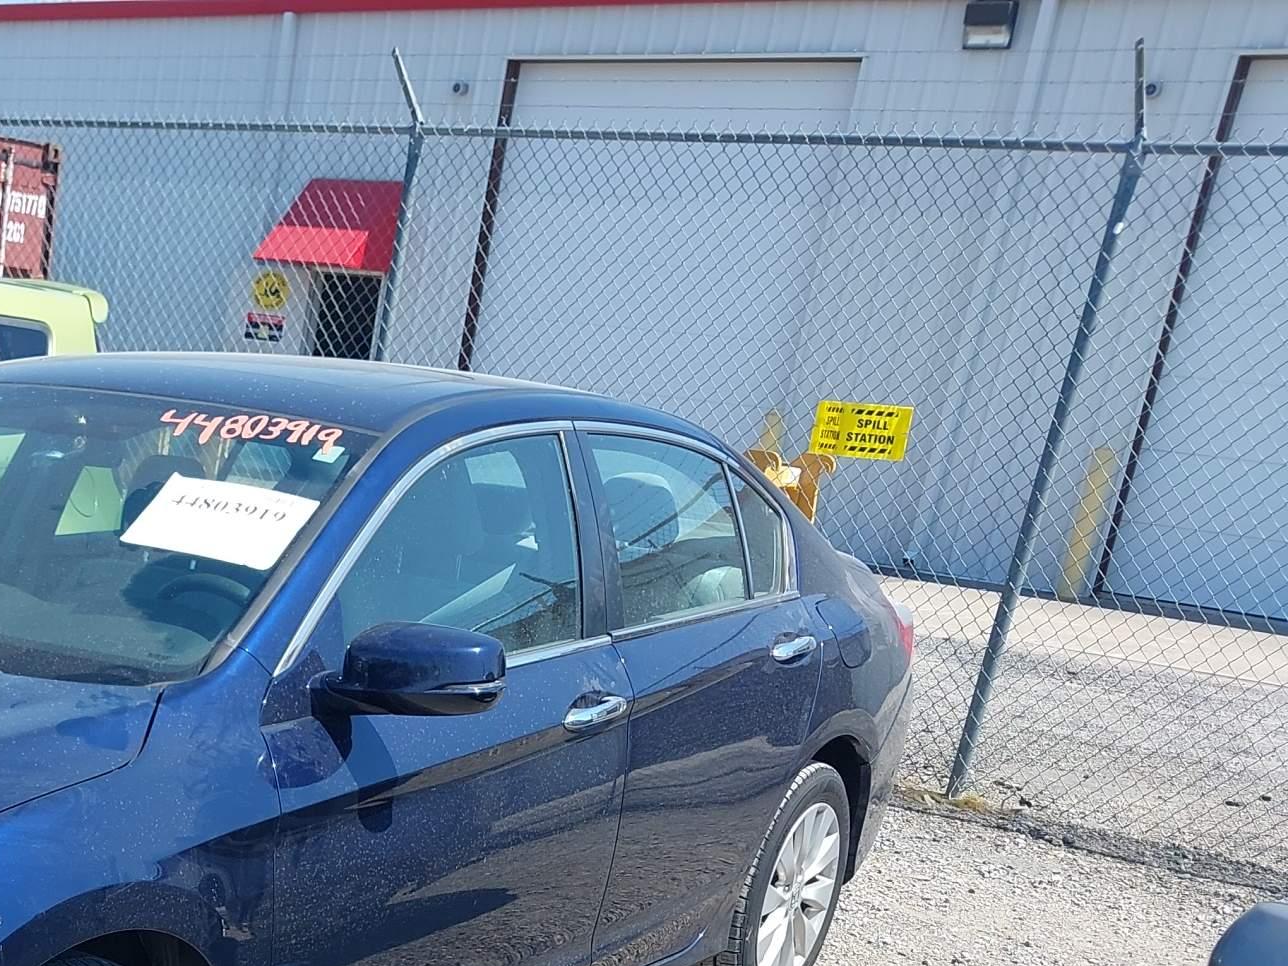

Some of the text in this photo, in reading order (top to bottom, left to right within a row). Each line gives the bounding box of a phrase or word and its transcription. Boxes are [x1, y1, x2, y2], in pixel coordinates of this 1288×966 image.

[160, 409, 344, 455] 44803919
[856, 418, 889, 431] SPILL
[845, 432, 895, 445] STATION
[171, 494, 288, 522] 44803919
